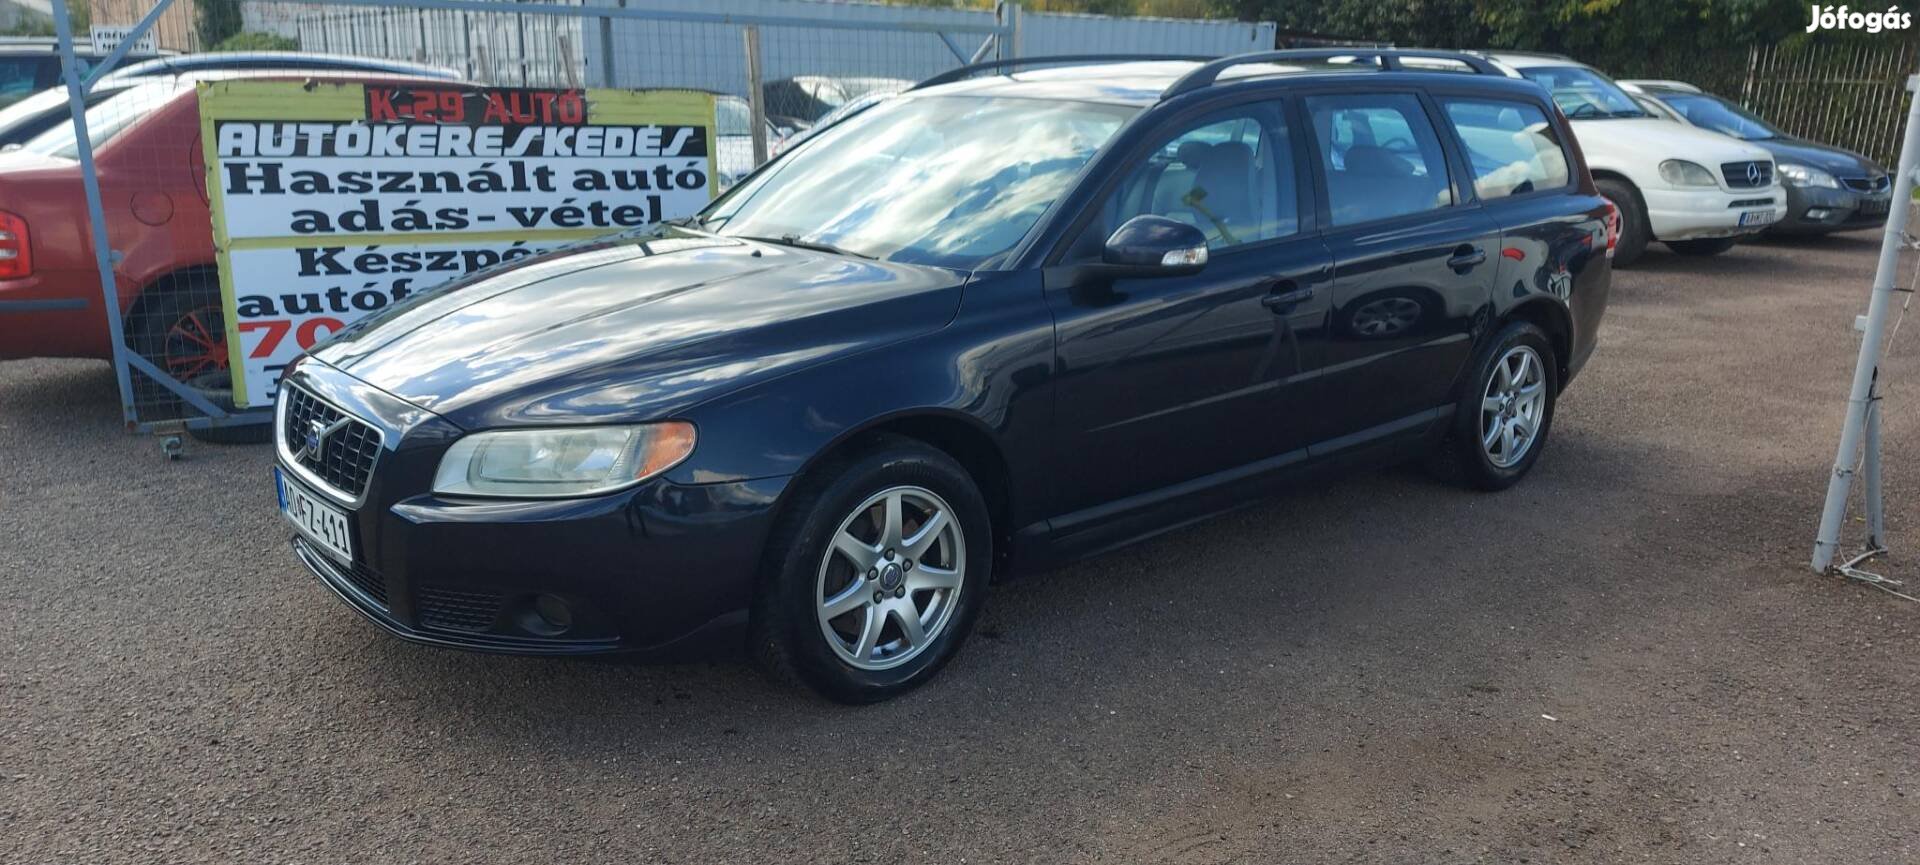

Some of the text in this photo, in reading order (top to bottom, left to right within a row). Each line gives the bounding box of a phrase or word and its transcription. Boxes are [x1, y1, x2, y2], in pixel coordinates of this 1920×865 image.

[369, 88, 583, 124] K-29 AUTÓ
[218, 122, 694, 157] AUTÓKERESKEDÉS
[224, 160, 706, 195] Használt autó
[296, 240, 549, 278] Készpé
[238, 278, 414, 319] autóf
